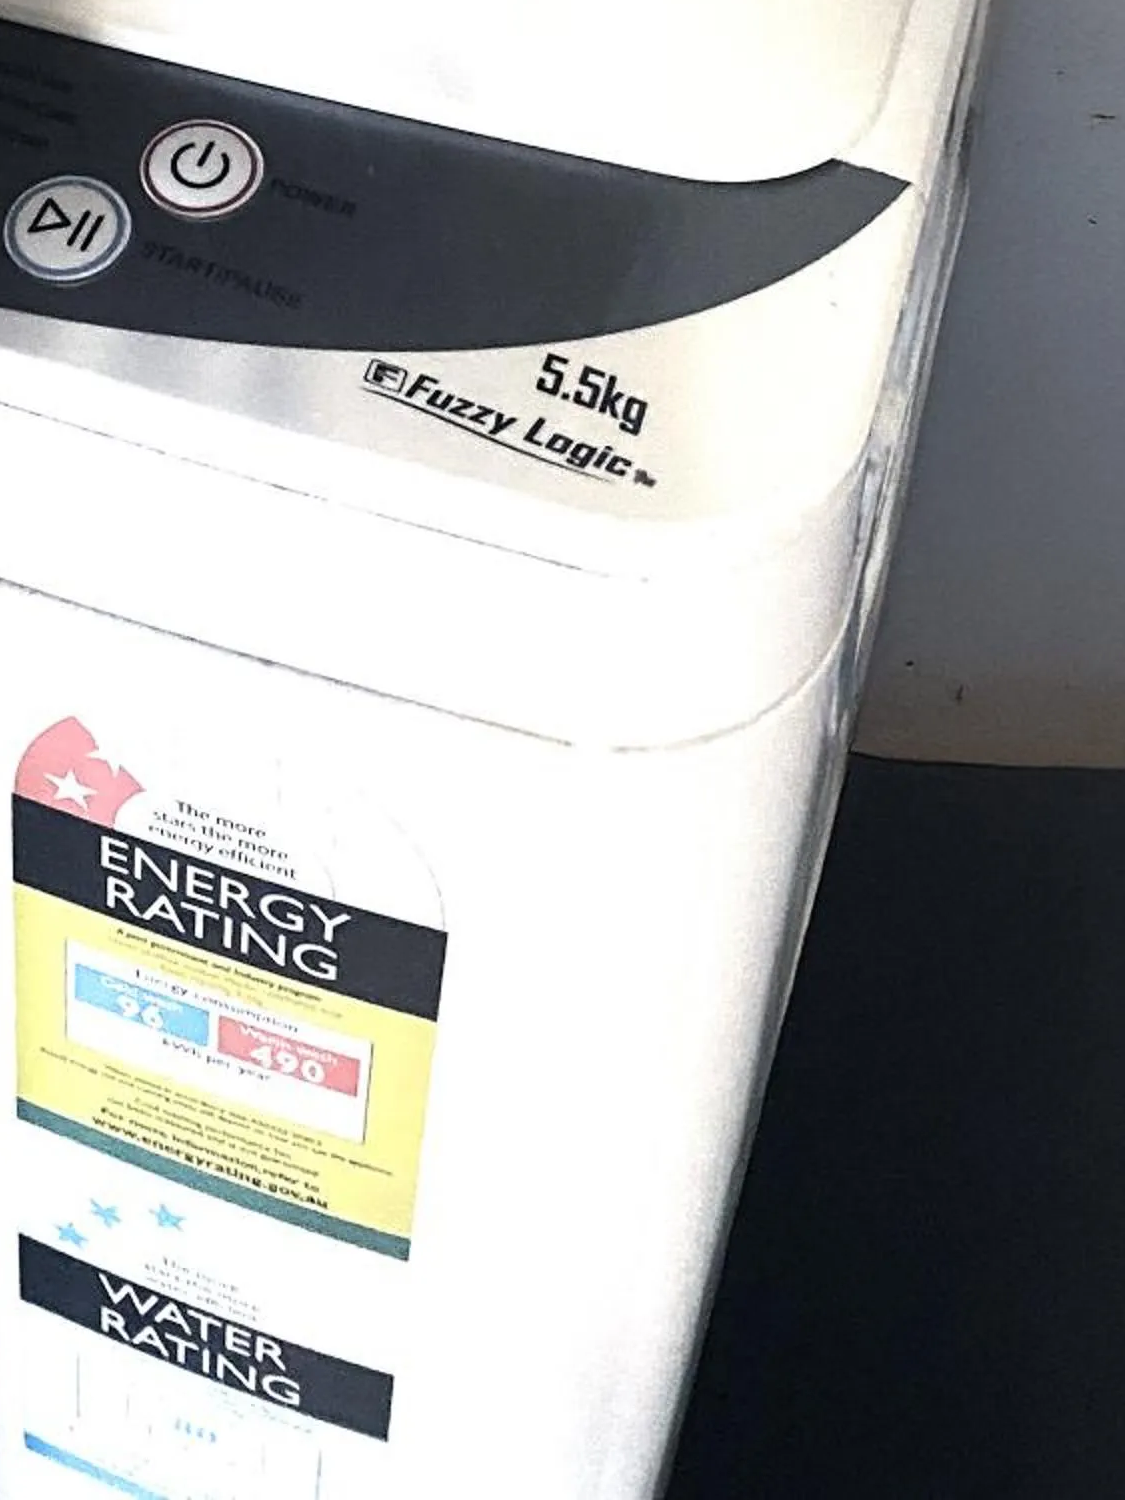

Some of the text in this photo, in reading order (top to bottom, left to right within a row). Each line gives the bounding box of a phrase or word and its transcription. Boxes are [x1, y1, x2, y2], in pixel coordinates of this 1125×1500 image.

[271, 178, 357, 219] POWER
[405, 373, 633, 477] Fuzzy Logic
[535, 352, 648, 436] 5.5kg
[148, 823, 299, 881] energy efficient
[152, 810, 288, 859] stars the more
[176, 800, 266, 838] The more
[100, 835, 352, 943] ENERGY
[106, 876, 338, 982] RATING
[249, 1043, 325, 1084] 490
[304, 1181, 321, 1193] to
[98, 1272, 287, 1371] WATER
[99, 1306, 302, 1408] RATING
